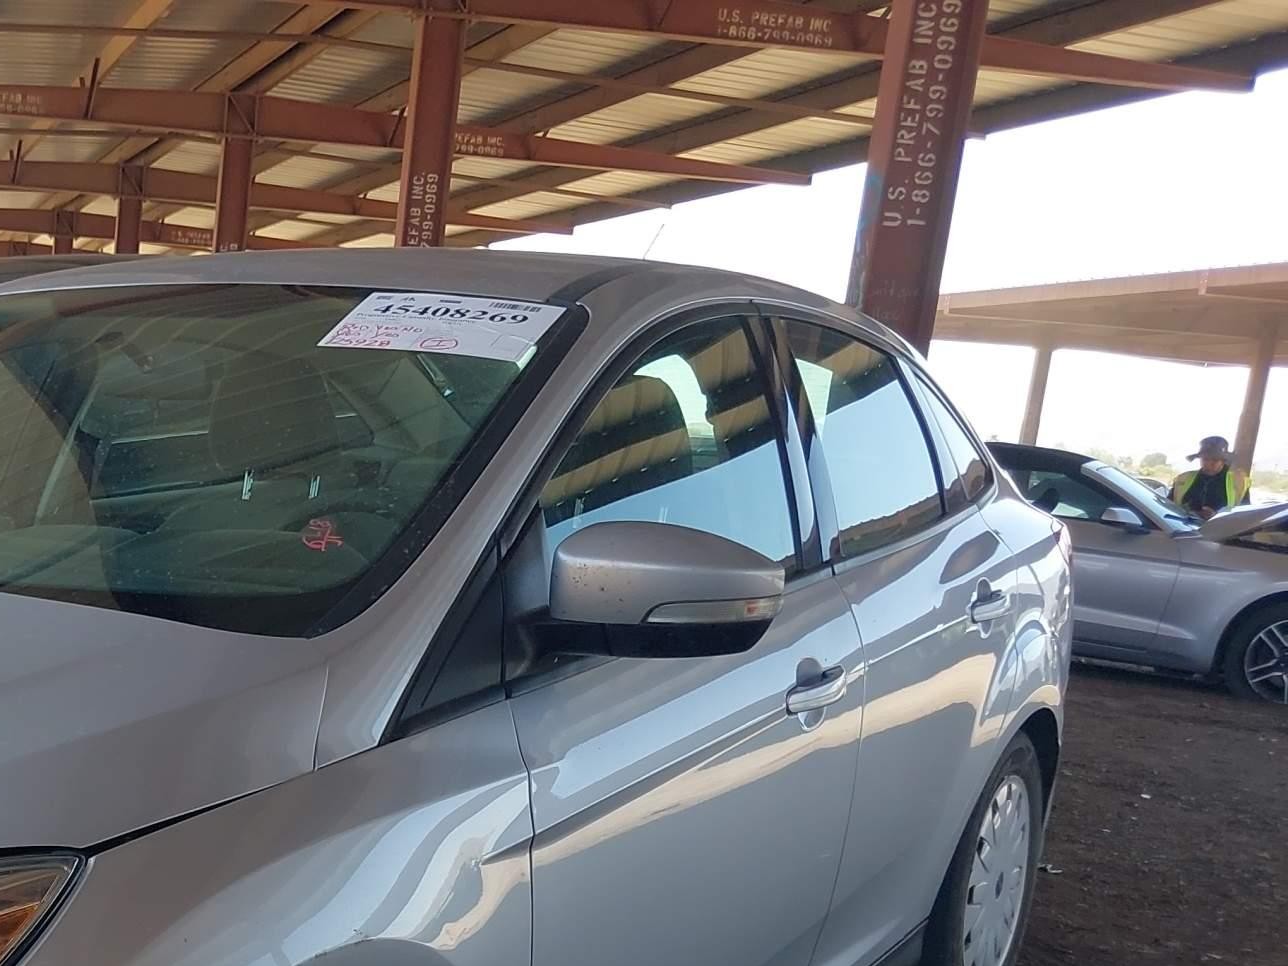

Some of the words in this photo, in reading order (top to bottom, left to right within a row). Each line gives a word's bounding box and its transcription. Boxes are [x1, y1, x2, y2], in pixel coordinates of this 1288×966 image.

[717, 7, 744, 23] U.S.
[752, 10, 804, 29] PREFAB
[809, 15, 832, 32] INC
[907, 0, 962, 227] 1-866-799-0969
[455, 132, 482, 145] EFAB
[455, 144, 504, 157] 799-0969
[882, 179, 908, 227] U.S.
[895, 59, 928, 162] PREFAB
[411, 171, 425, 200] INC.
[419, 173, 439, 248] 799-0969
[408, 207, 421, 246] EFAB
[373, 303, 529, 325] 45408269
